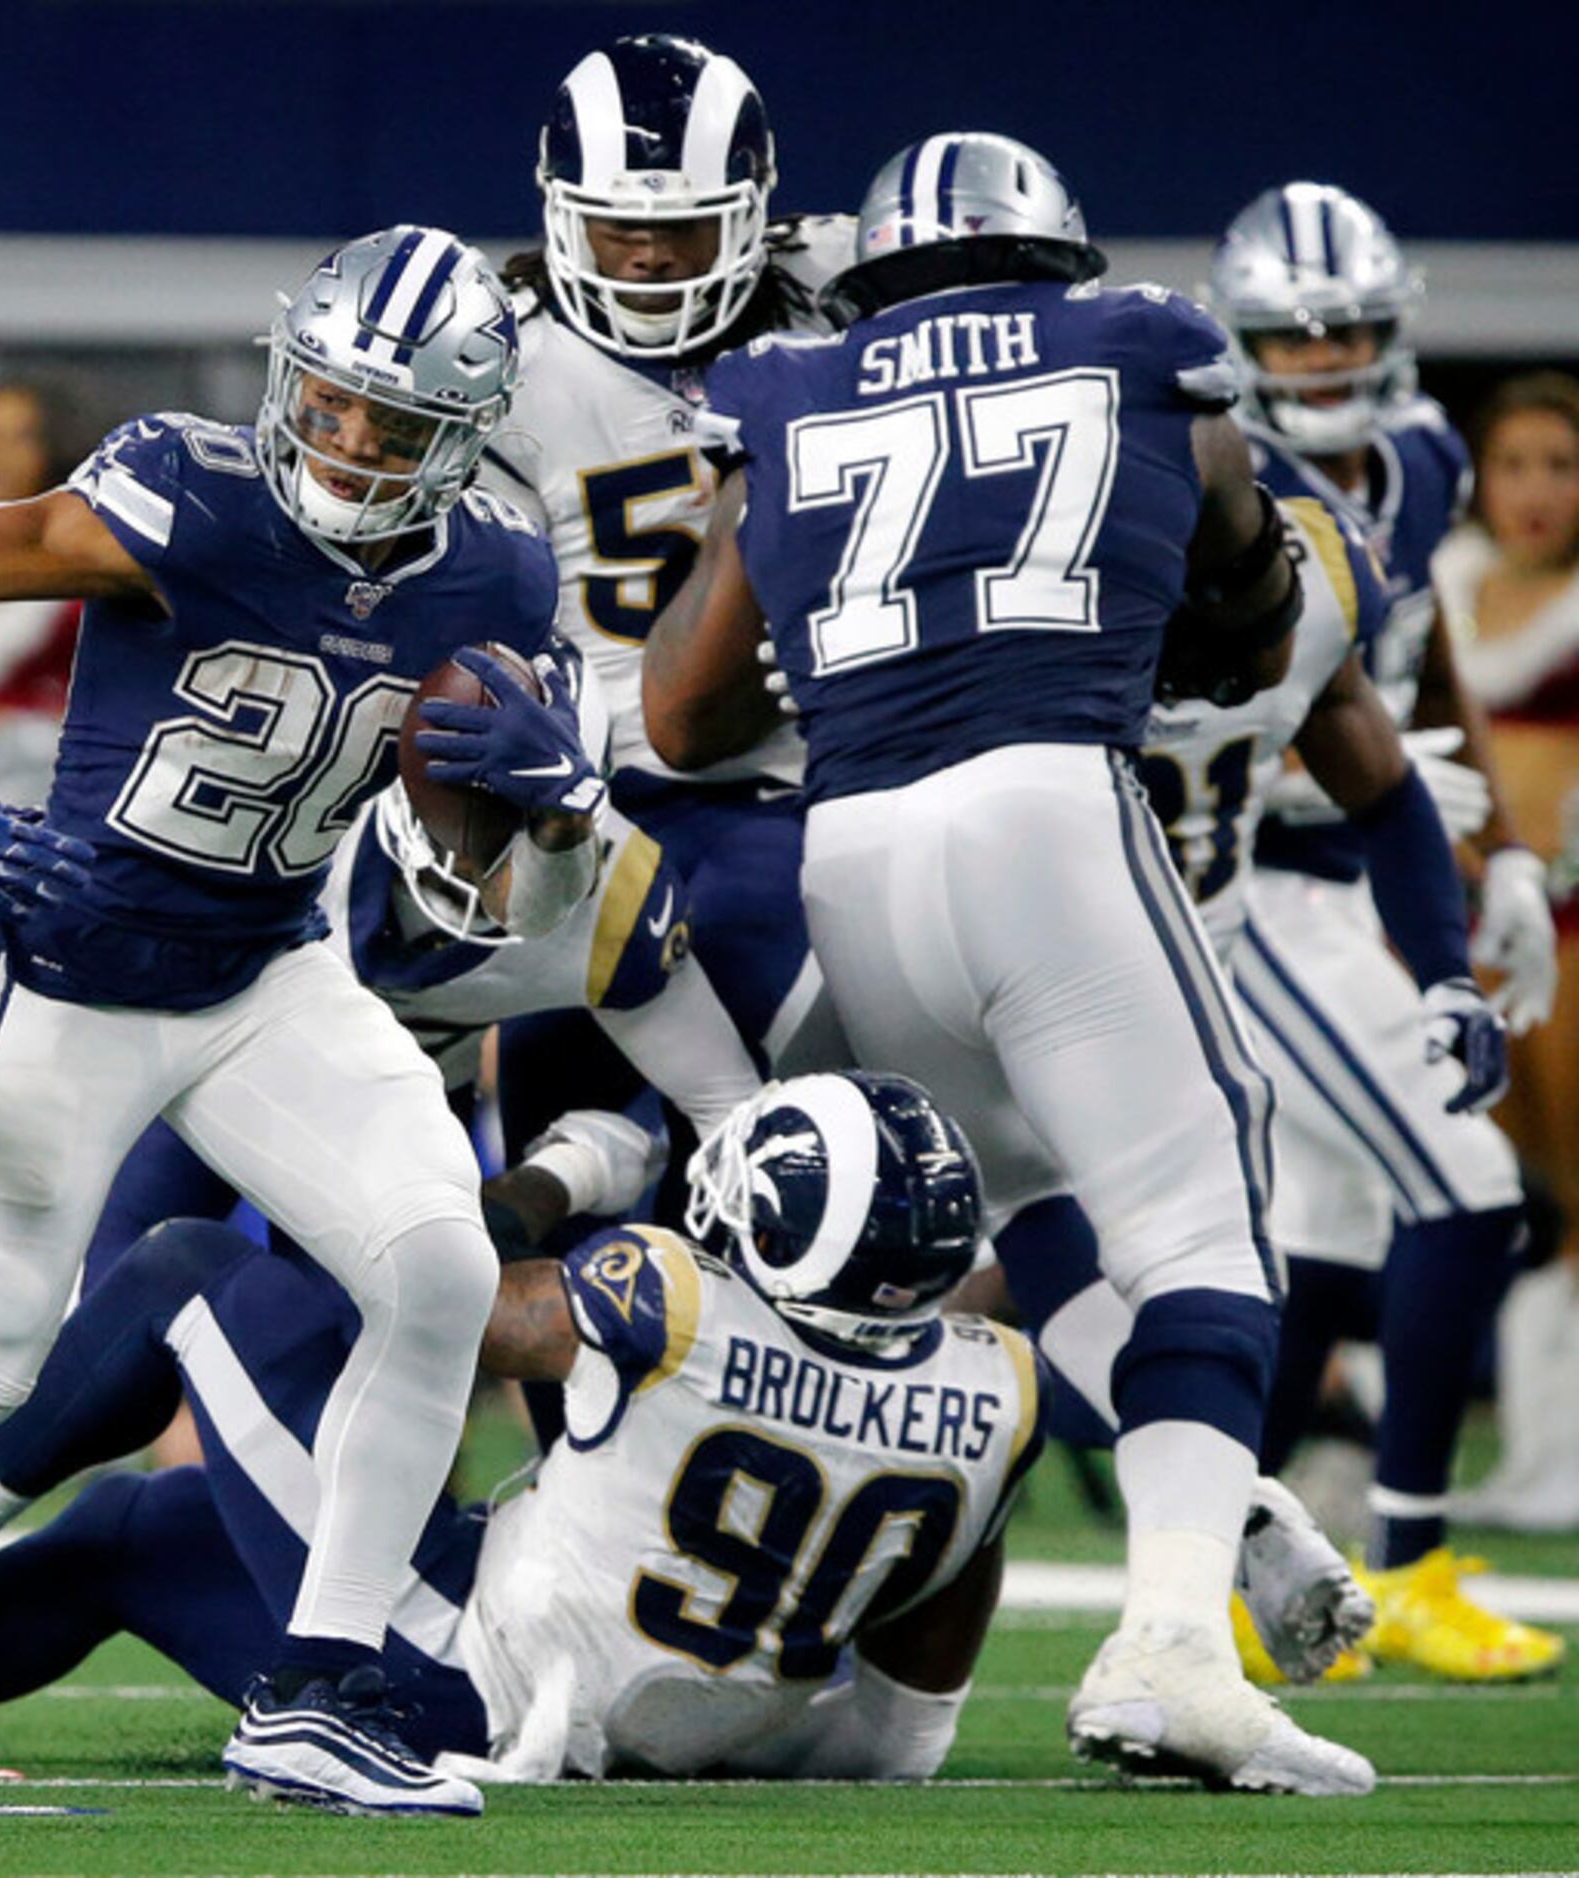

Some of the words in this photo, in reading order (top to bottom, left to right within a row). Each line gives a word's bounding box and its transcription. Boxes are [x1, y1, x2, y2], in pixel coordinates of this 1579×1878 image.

[857, 312, 1041, 396] SMITH
[577, 446, 723, 647] 5
[786, 367, 1120, 677] 77
[105, 640, 421, 878] 20
[721, 1334, 1001, 1461] BROCKERS
[627, 1422, 967, 1679] 90
